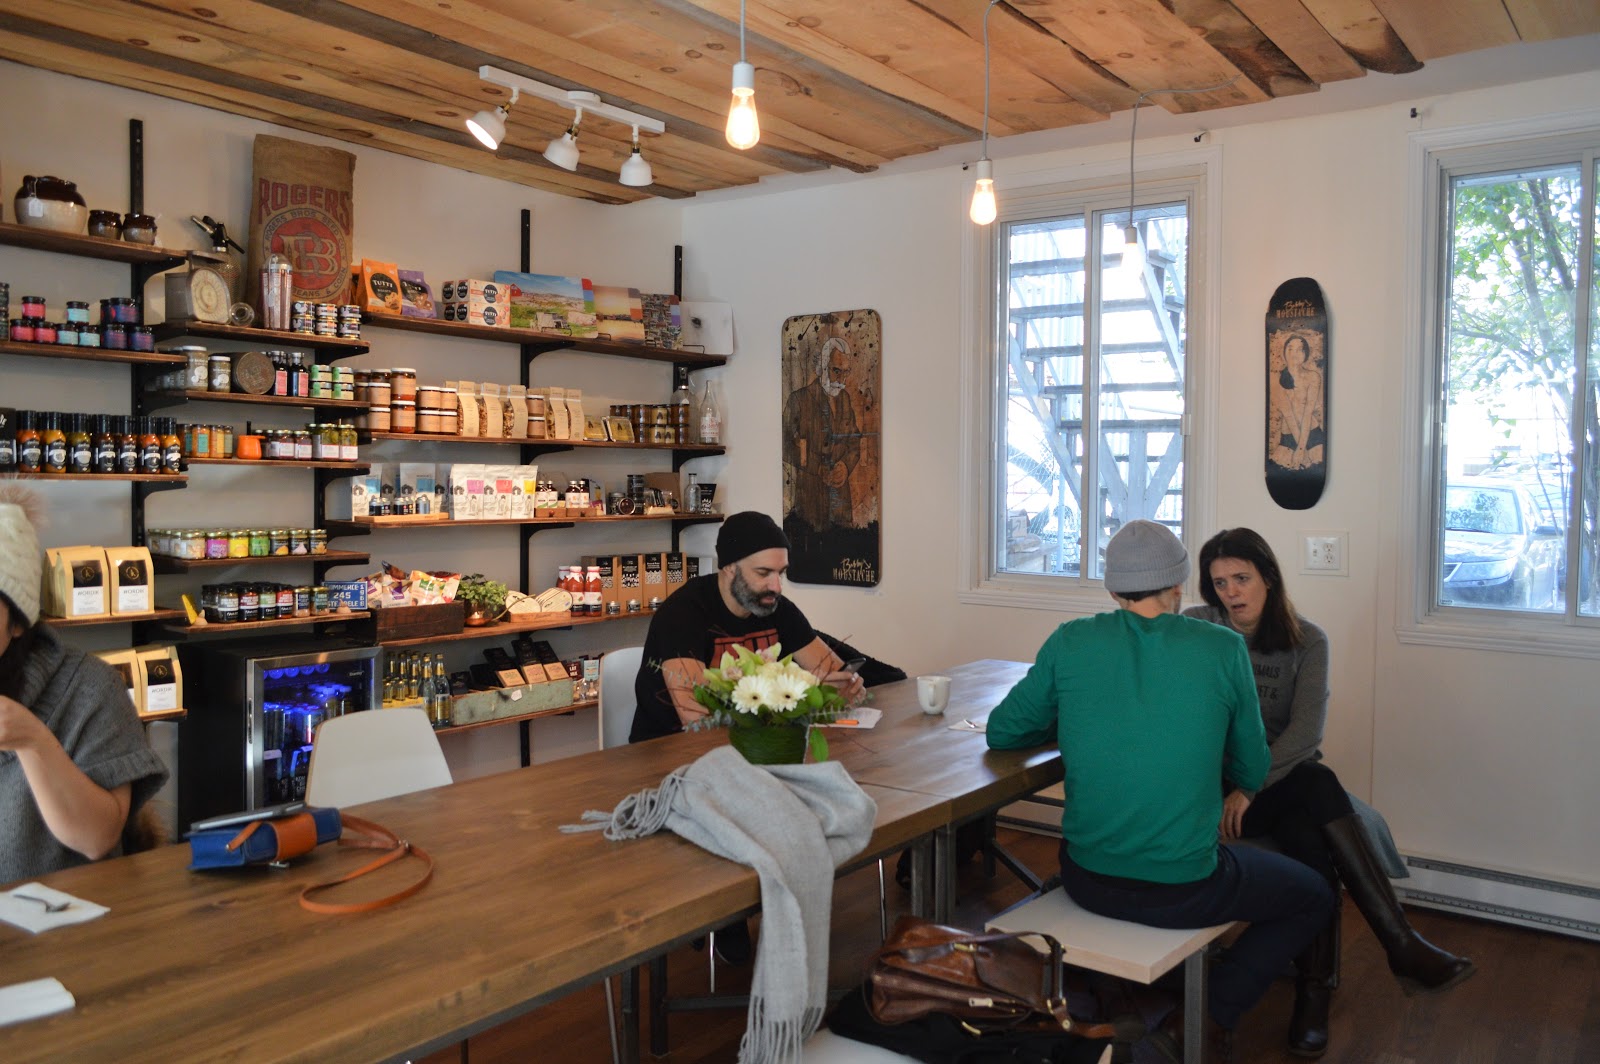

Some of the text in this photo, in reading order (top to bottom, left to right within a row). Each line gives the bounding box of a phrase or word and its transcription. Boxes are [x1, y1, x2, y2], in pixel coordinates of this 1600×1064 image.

[259, 177, 350, 236] ROGERS
[265, 215, 288, 241] ROGERS
[290, 210, 317, 218] BROS
[322, 216, 340, 236] SEED
[372, 280, 393, 288] TUTTI
[832, 567, 875, 582] MOUSTACHE
